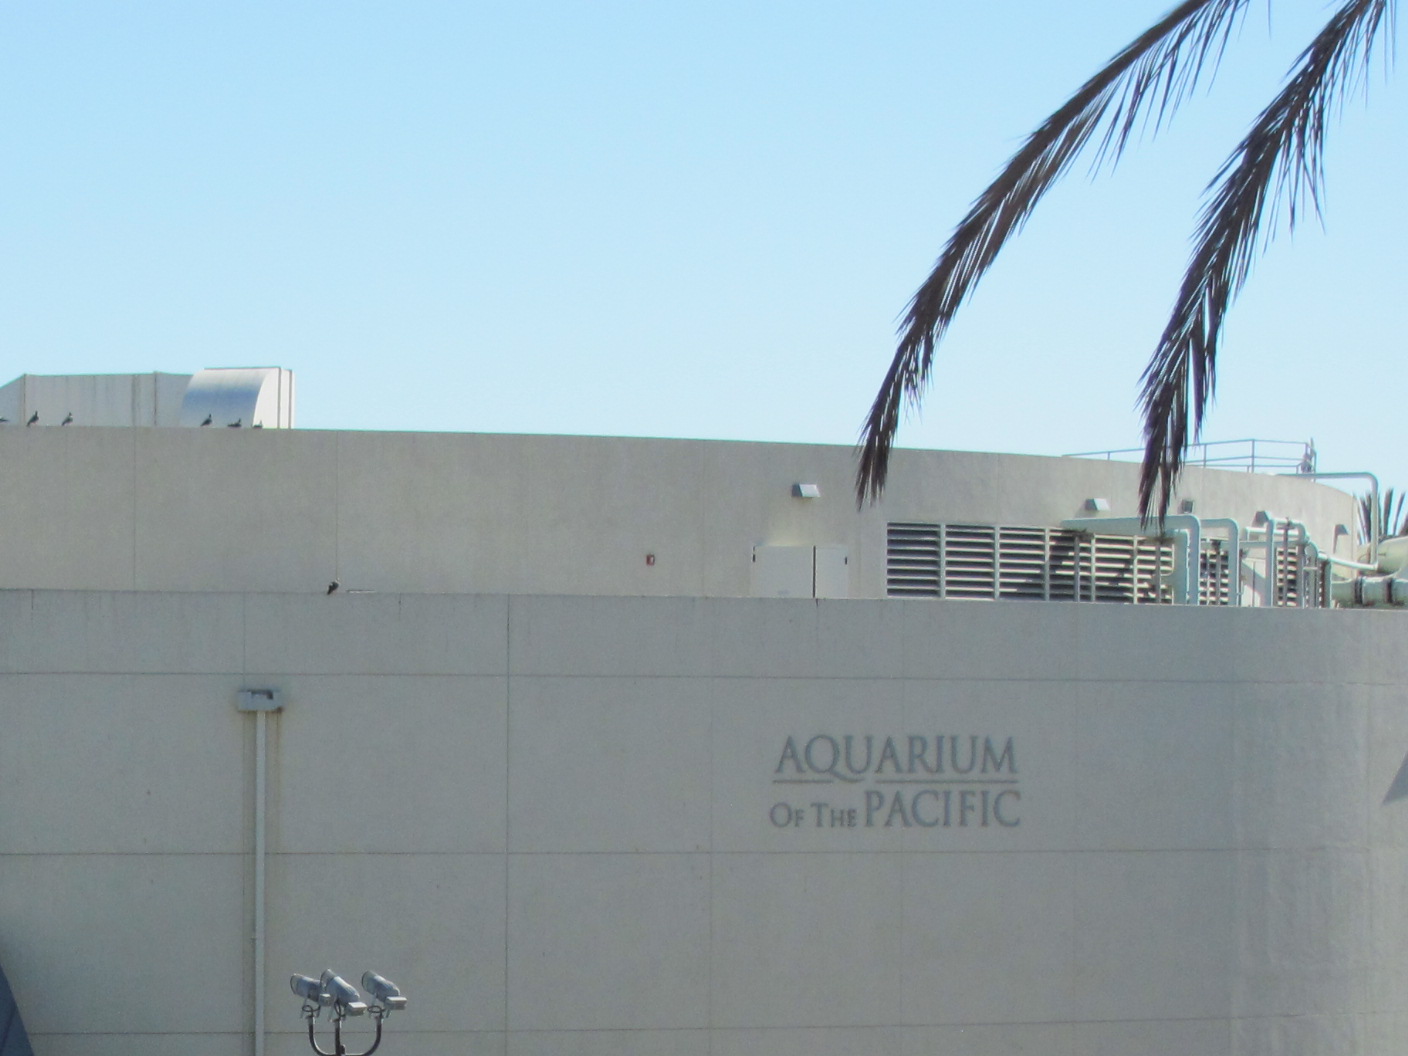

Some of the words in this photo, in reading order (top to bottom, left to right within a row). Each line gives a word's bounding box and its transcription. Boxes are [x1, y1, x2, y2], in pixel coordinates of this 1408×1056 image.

[774, 734, 1019, 783] AQUARIUM
[769, 802, 805, 828] OF
[863, 789, 1022, 828] PACIFIC
